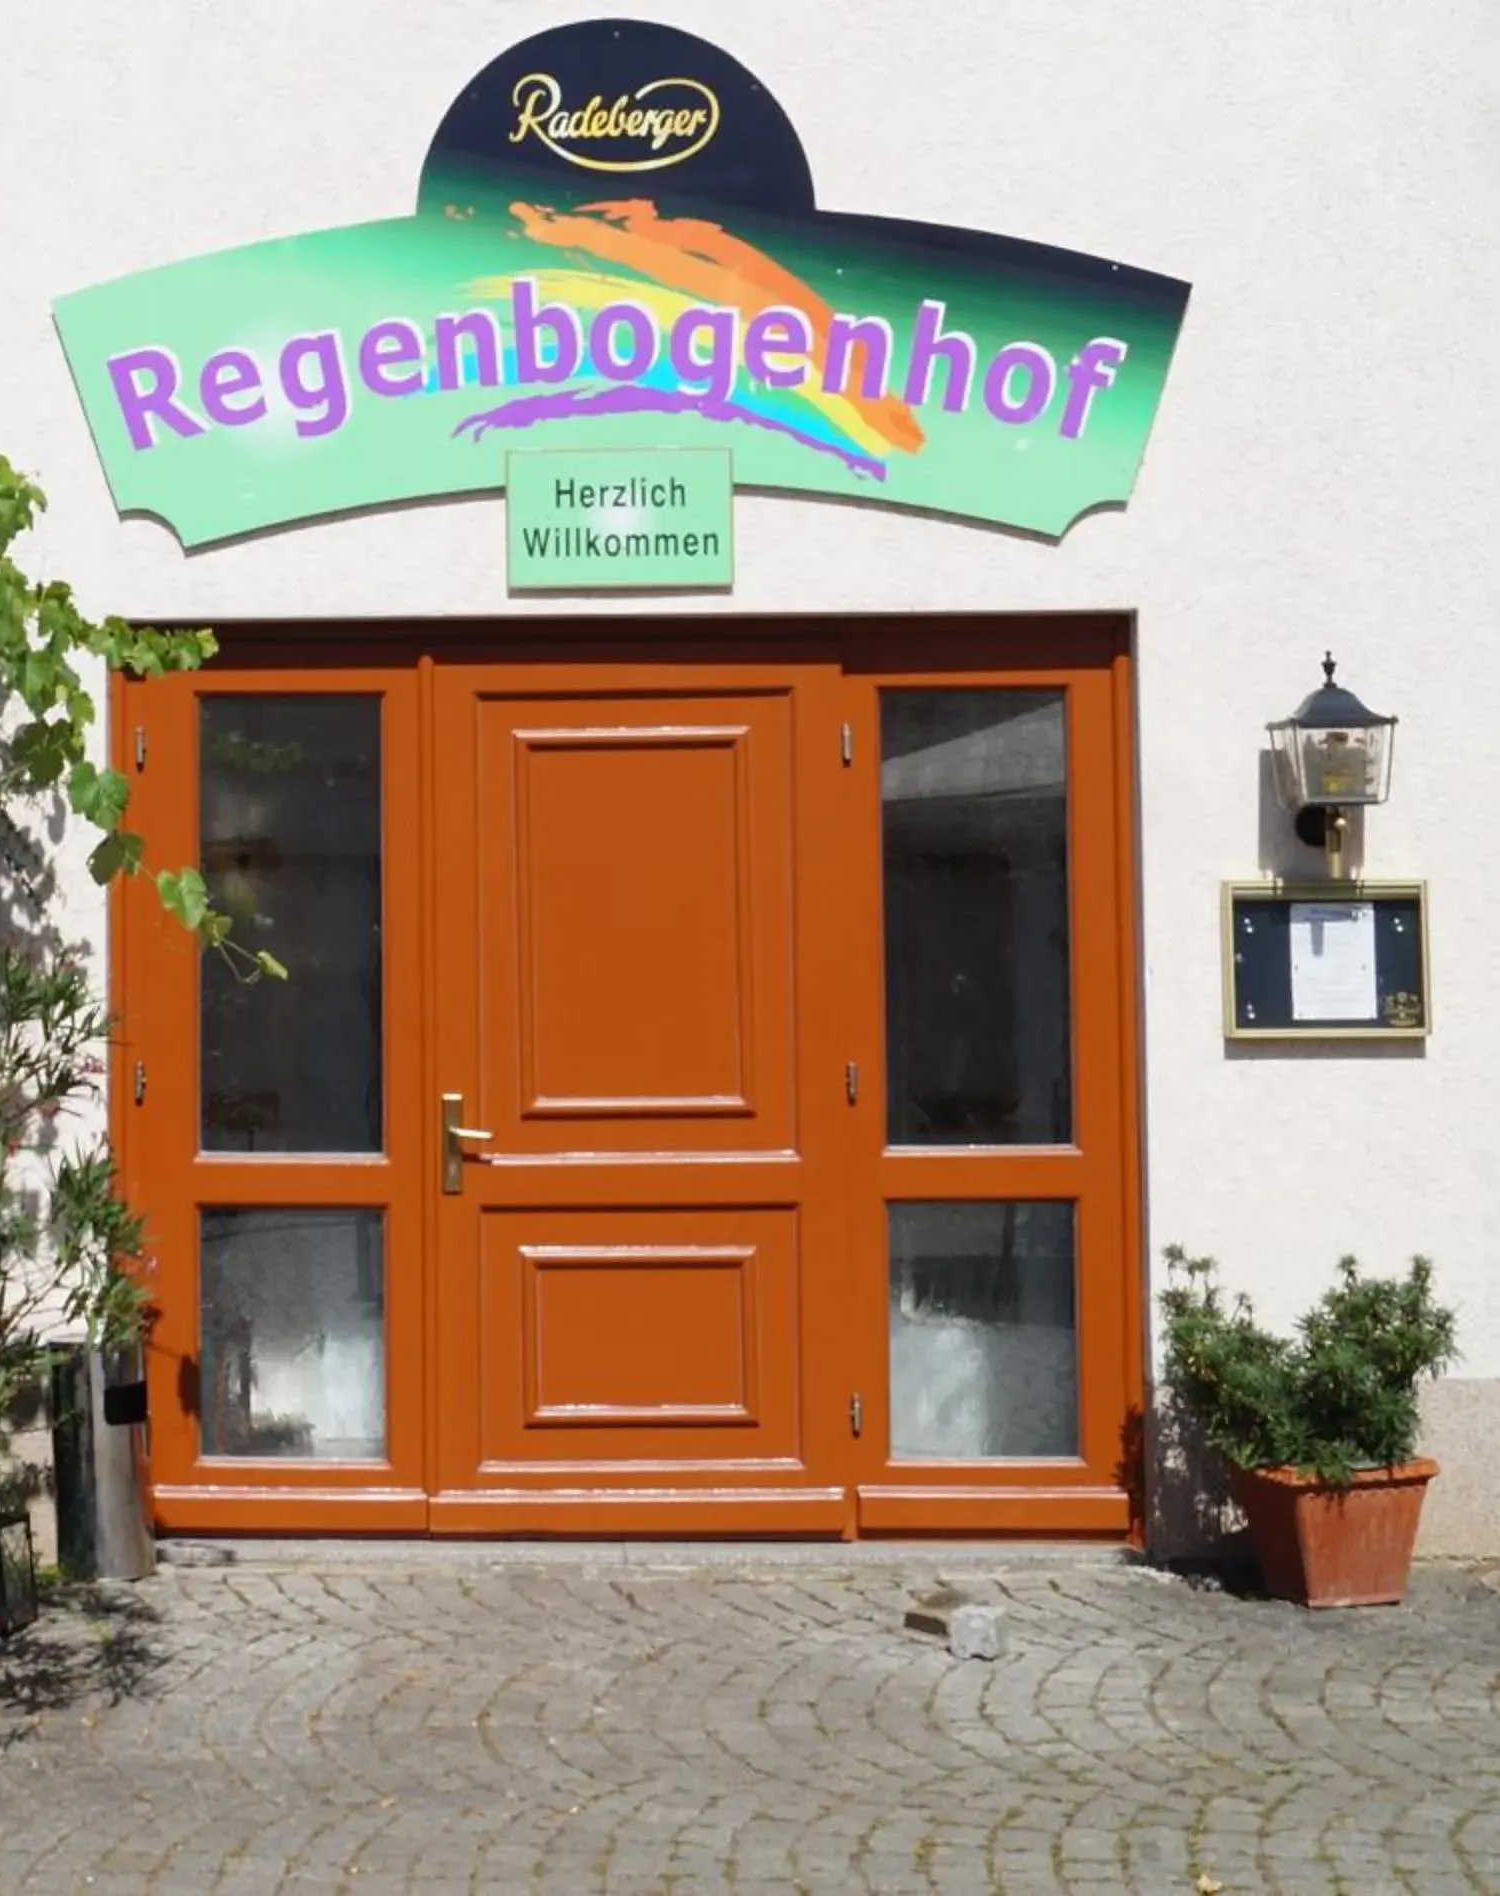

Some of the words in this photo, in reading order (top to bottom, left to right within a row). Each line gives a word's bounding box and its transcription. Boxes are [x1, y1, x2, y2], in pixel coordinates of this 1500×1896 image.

[508, 72, 715, 162] Radeberger
[106, 278, 1127, 450] Regenbogenhof
[555, 477, 687, 509] Herzlich
[523, 527, 720, 558] Willkommen
